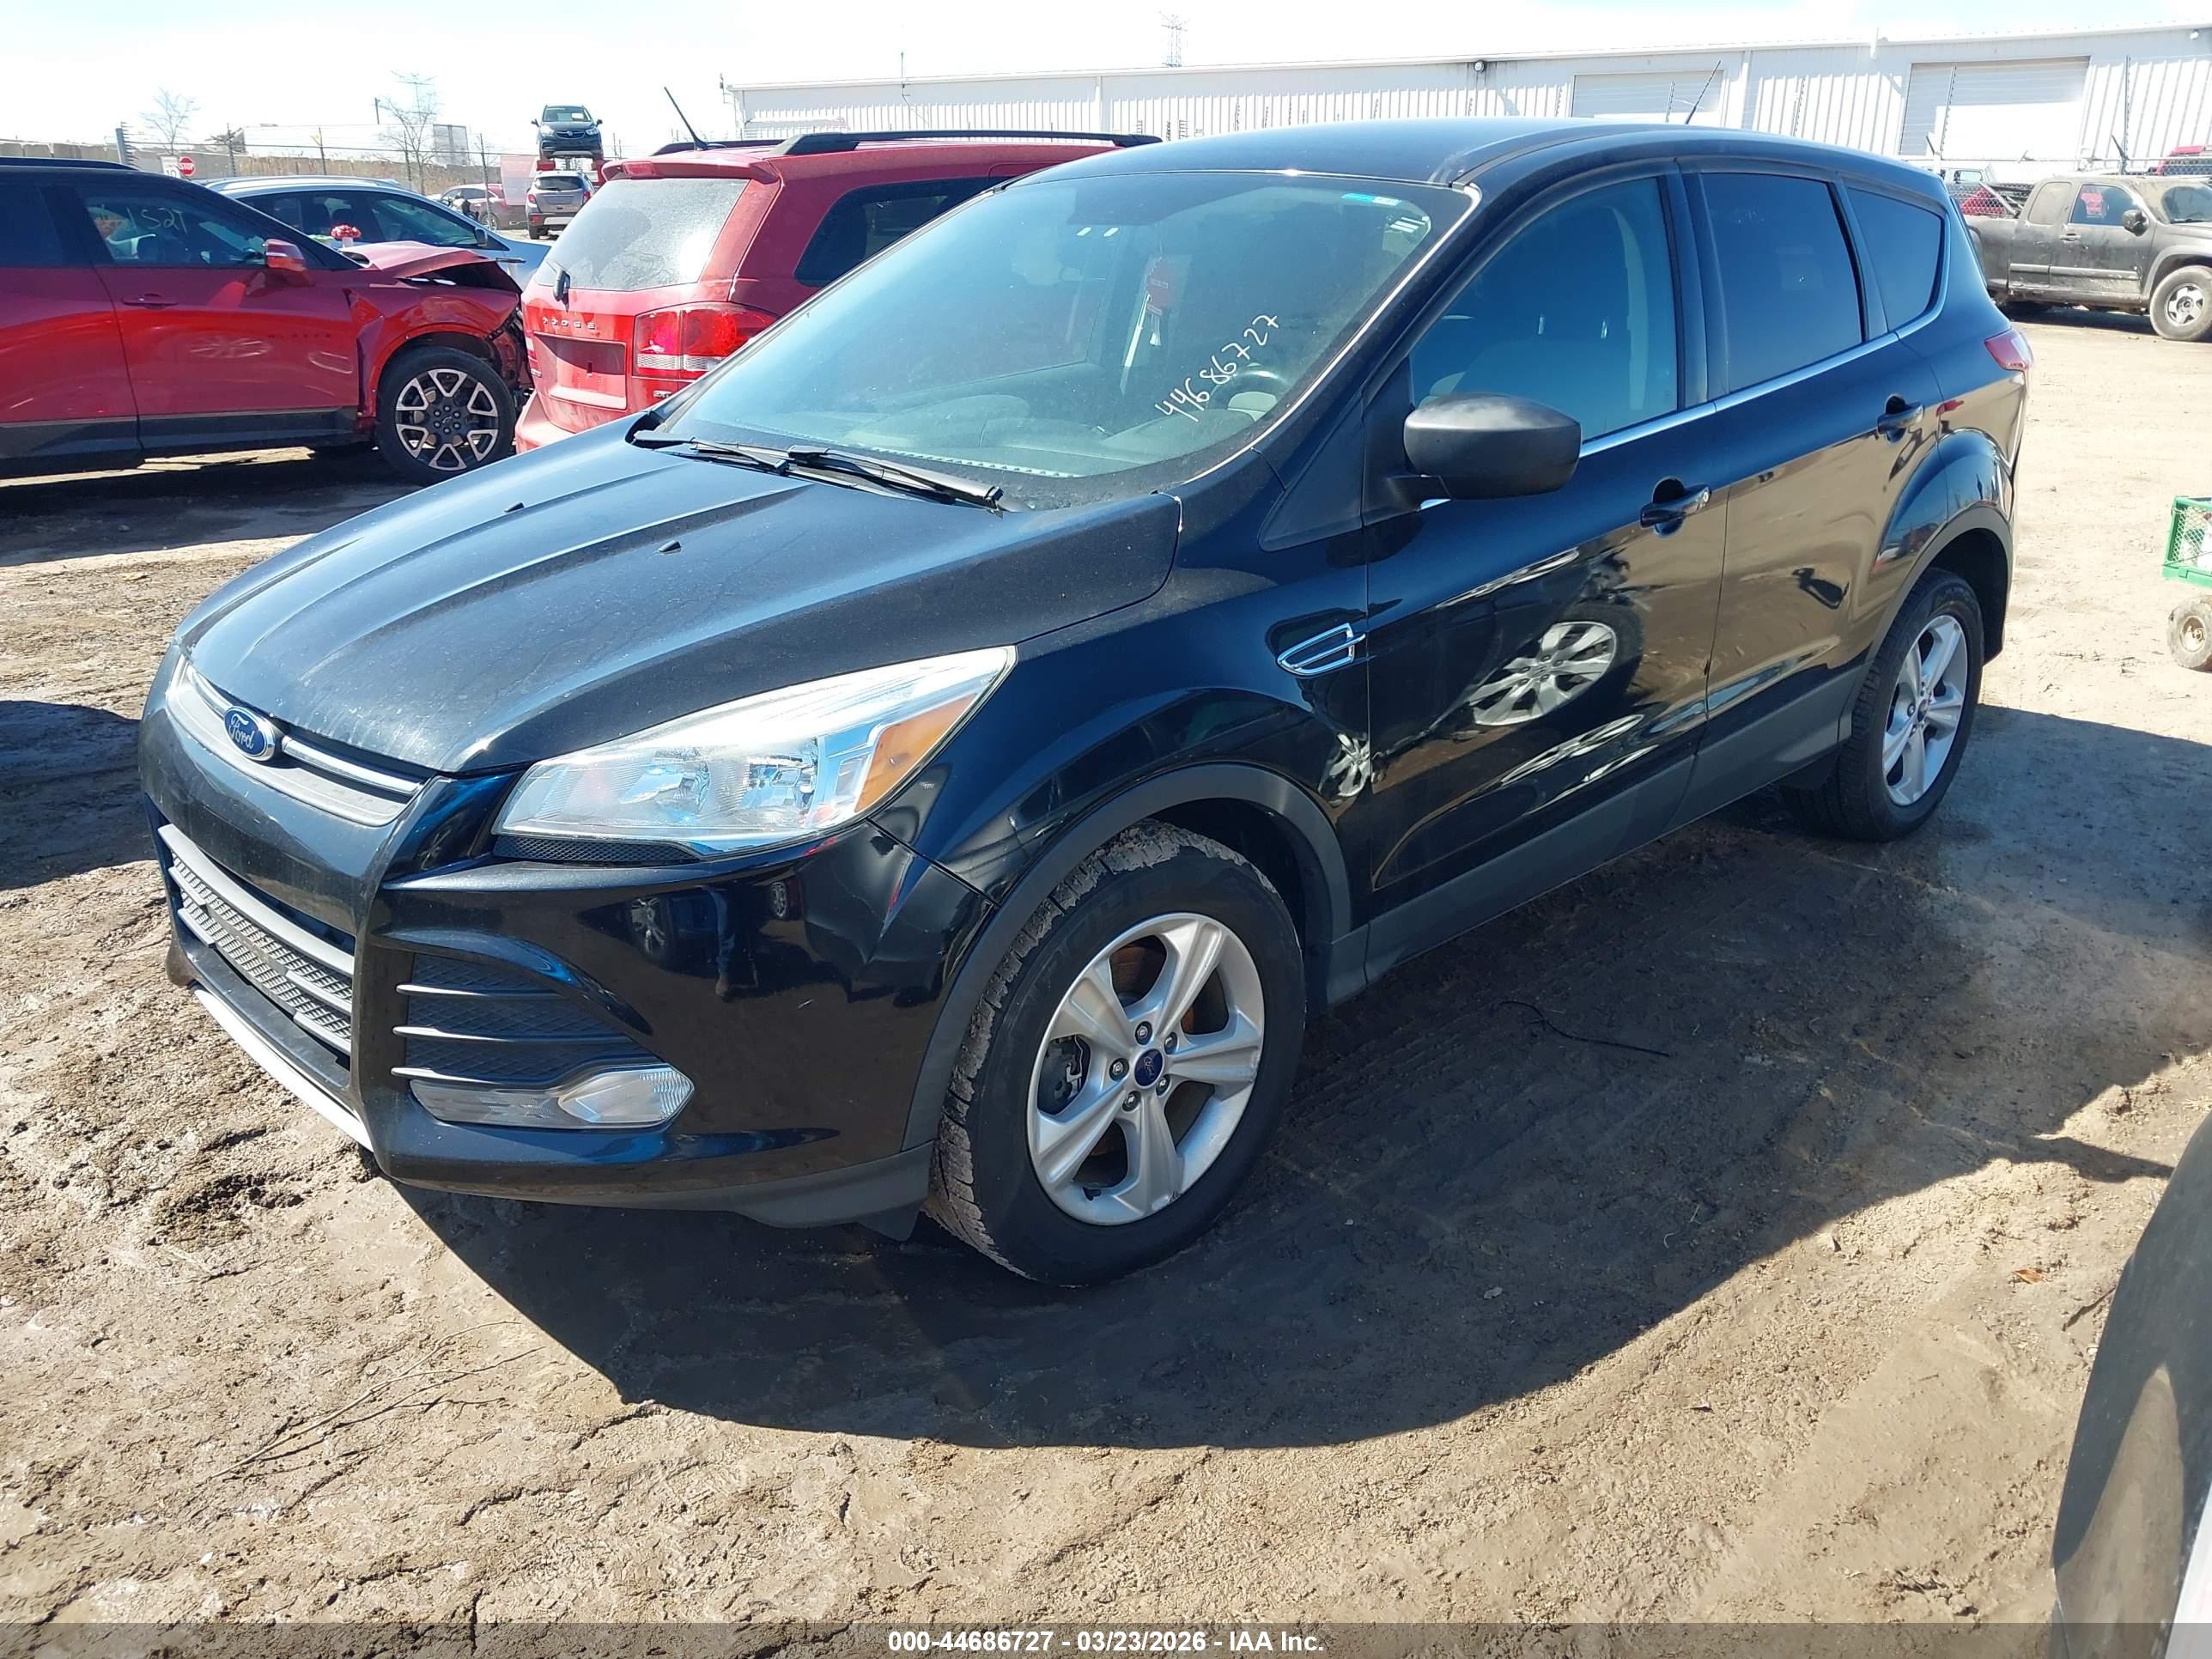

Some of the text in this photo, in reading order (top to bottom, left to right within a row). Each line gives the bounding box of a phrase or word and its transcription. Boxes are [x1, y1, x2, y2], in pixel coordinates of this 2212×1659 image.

[542, 317, 596, 329] DODGE
[1154, 314, 1279, 422] 44686727
[228, 714, 255, 750] Ford
